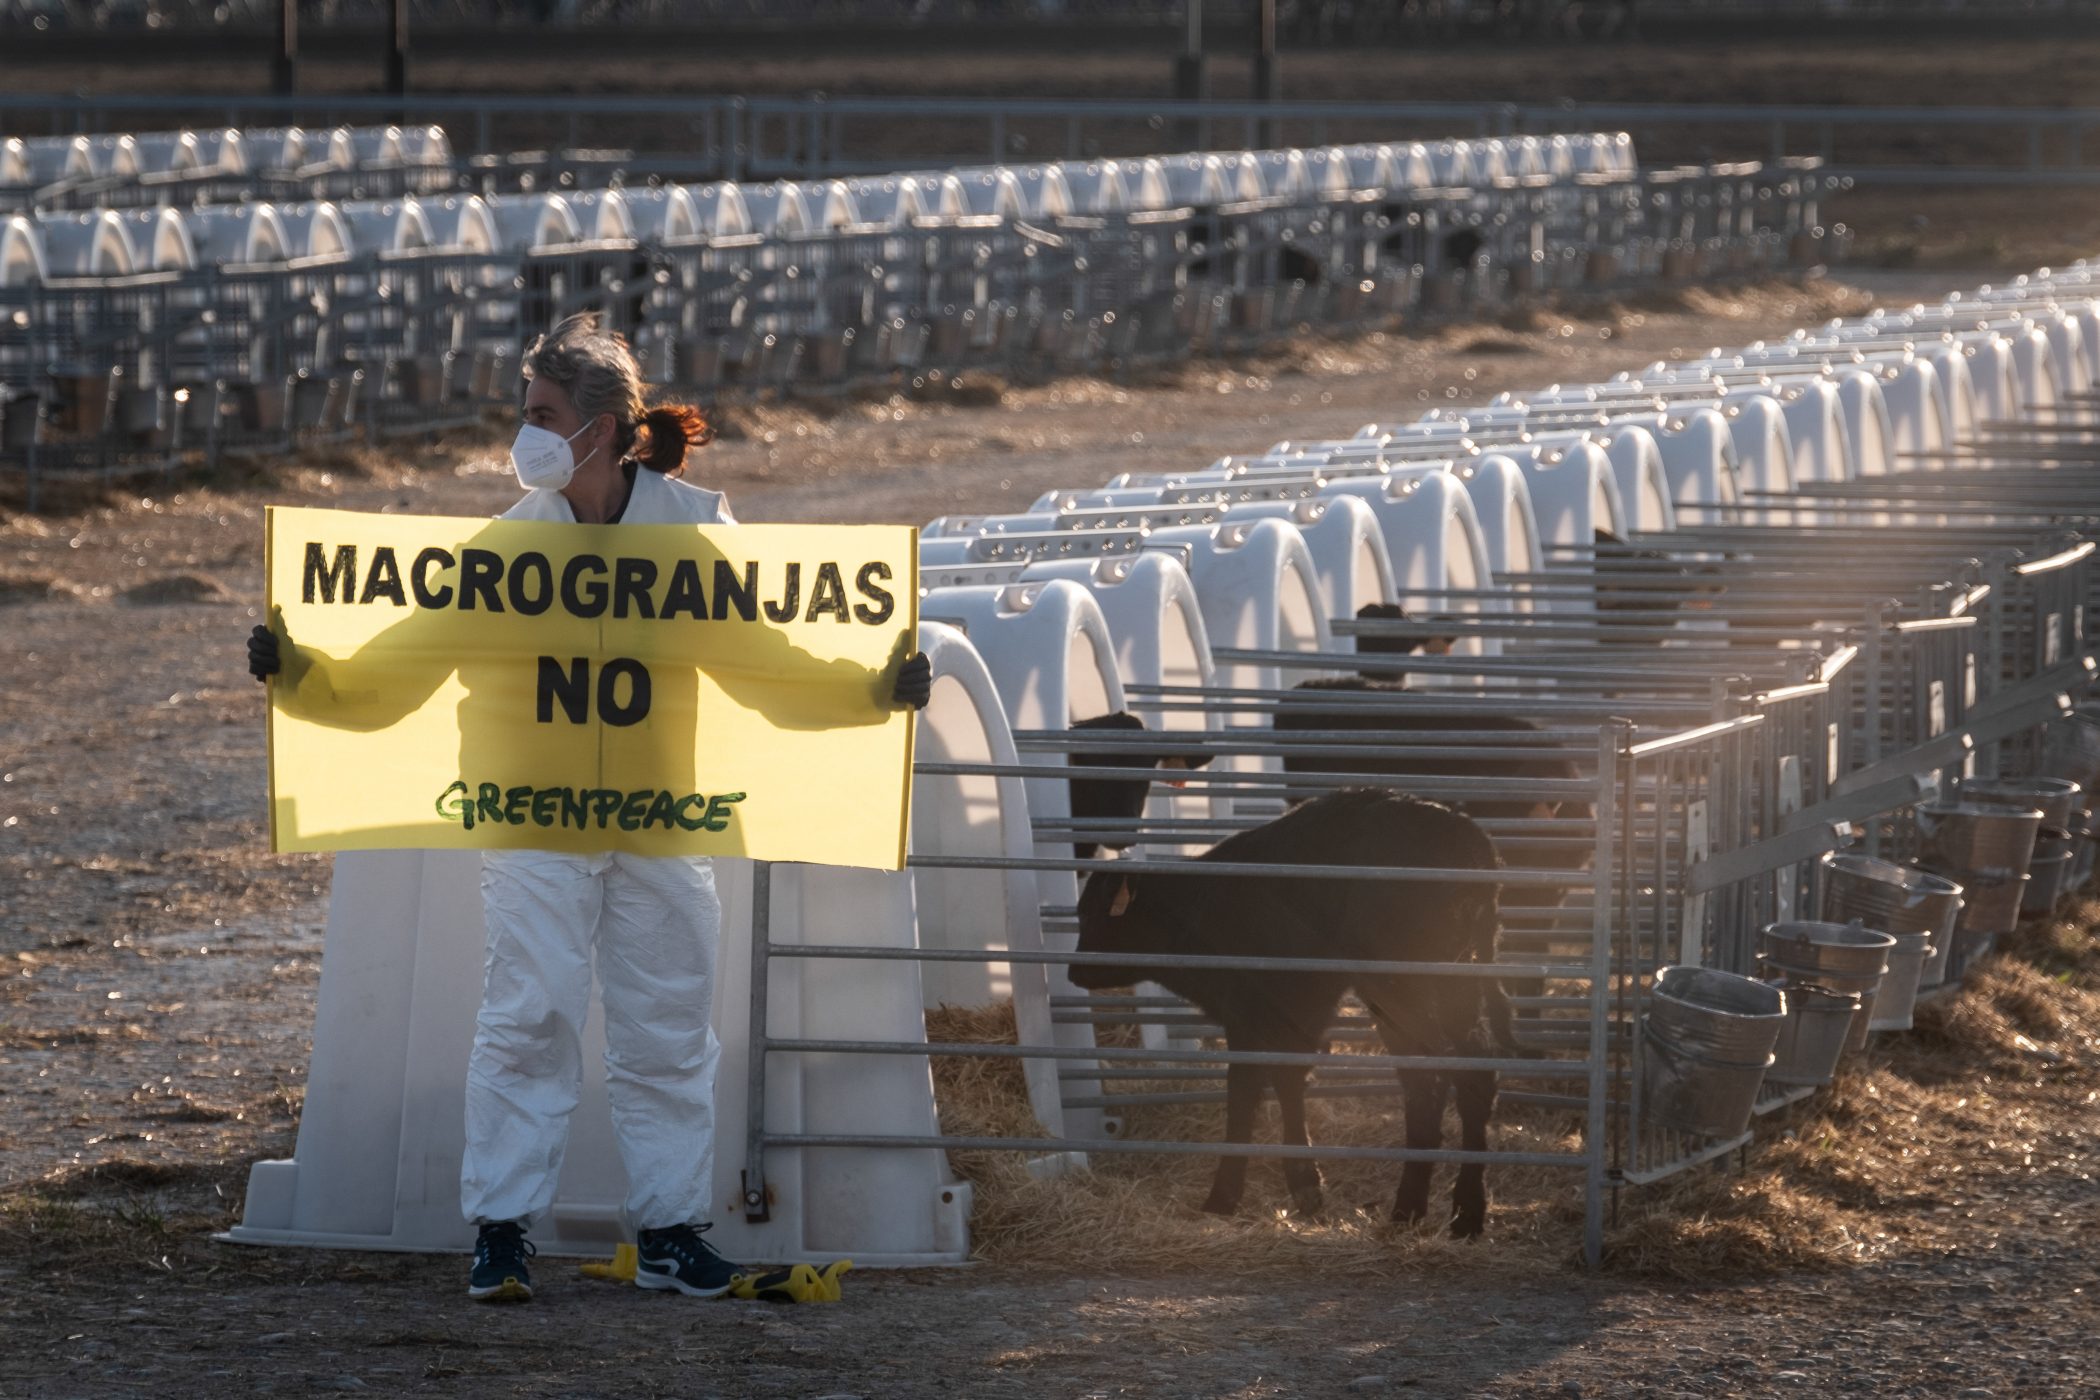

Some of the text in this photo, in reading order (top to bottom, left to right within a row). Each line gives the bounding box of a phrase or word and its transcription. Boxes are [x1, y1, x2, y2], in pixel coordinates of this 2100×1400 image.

[303, 542, 893, 625] MACROGRANJAS
[536, 656, 652, 726] NO
[435, 780, 747, 832] GREENPEACE
